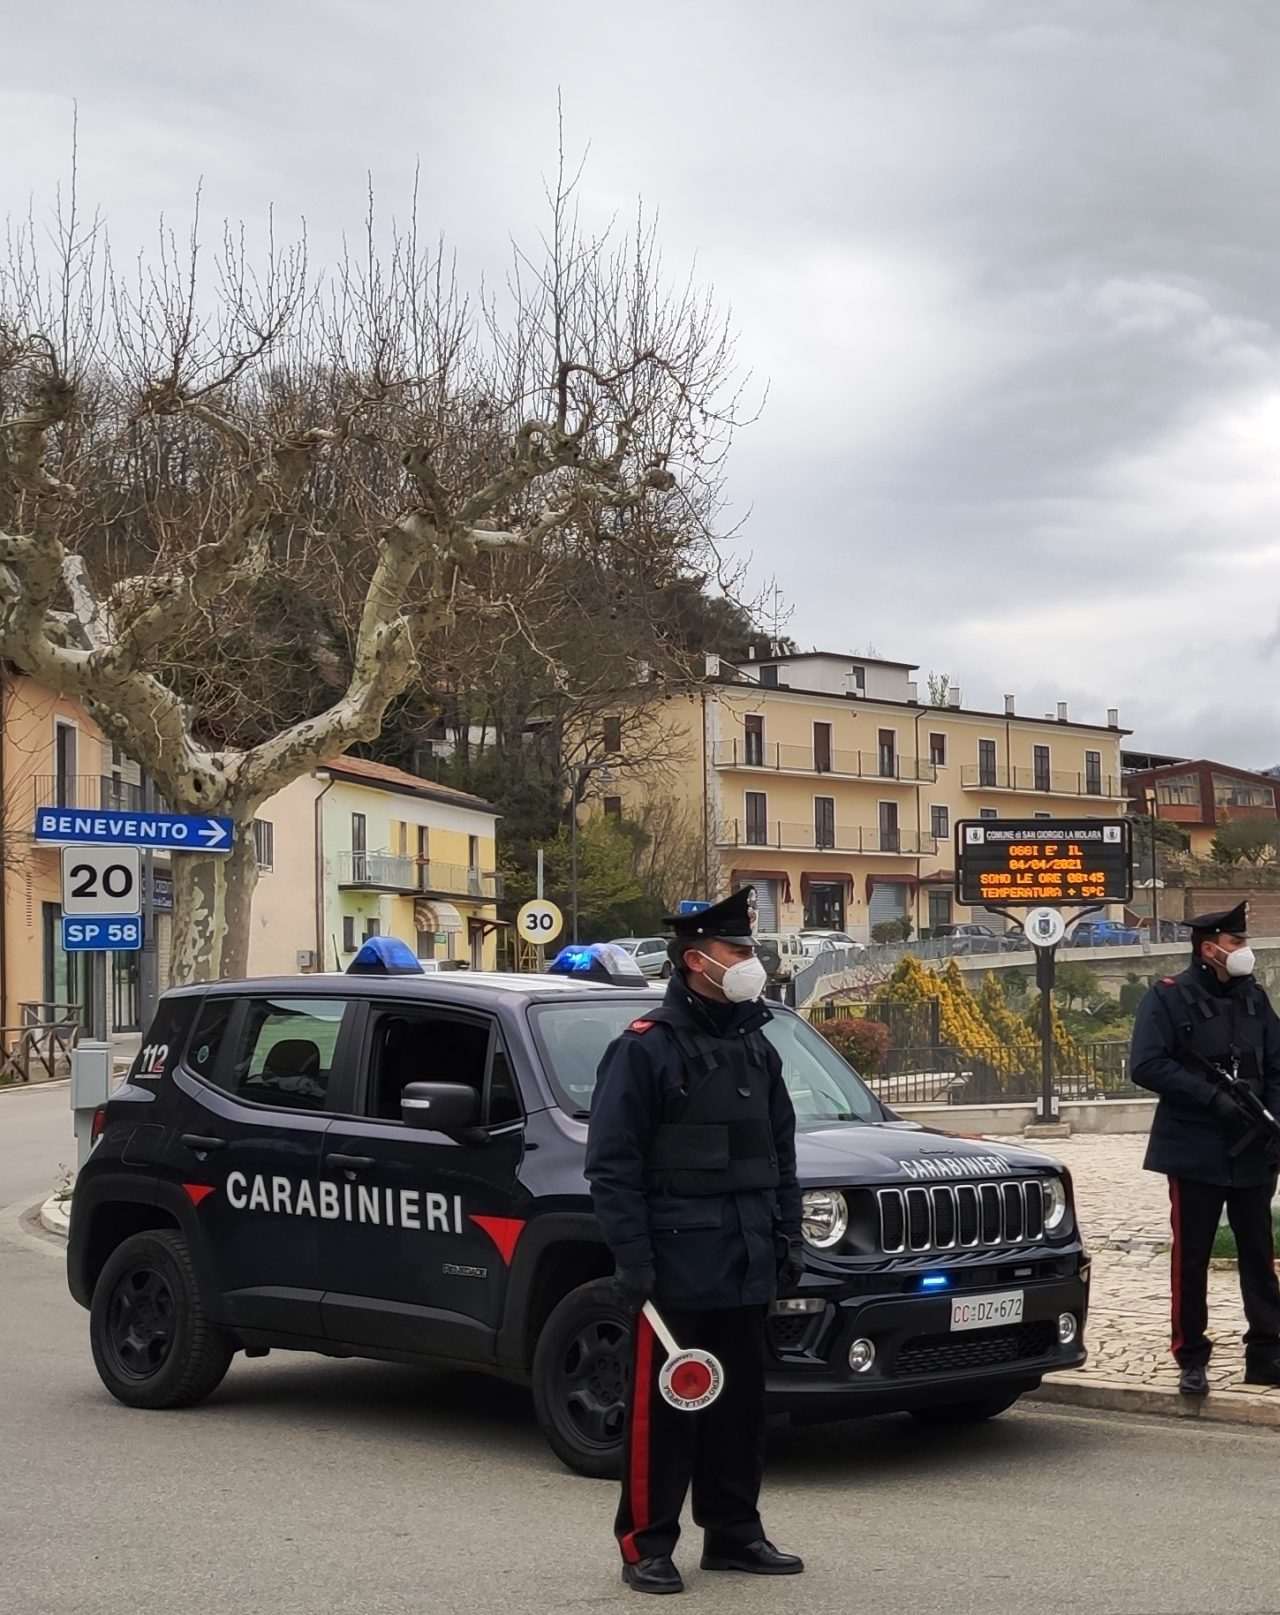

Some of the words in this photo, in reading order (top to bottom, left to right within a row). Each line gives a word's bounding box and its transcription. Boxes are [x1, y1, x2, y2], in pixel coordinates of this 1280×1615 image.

[42, 816, 188, 839] BENEVENTO
[986, 831, 1014, 839] COMUNE
[1022, 830, 1036, 839] SAN
[1037, 830, 1064, 839] GIORGIO
[1065, 830, 1073, 839] LA
[1068, 845, 1083, 856] IL
[69, 864, 133, 898] 20
[980, 873, 1011, 884] SONO
[1016, 873, 1033, 884] LE
[1038, 873, 1062, 884] ORE
[980, 887, 1062, 899] TEMPERATURA
[525, 913, 553, 931] 30
[67, 924, 100, 942] SP
[107, 924, 137, 942] 58
[140, 1044, 169, 1073] 112
[899, 1156, 1012, 1179] CARABINIERI
[226, 1170, 464, 1234] CARABINIERI
